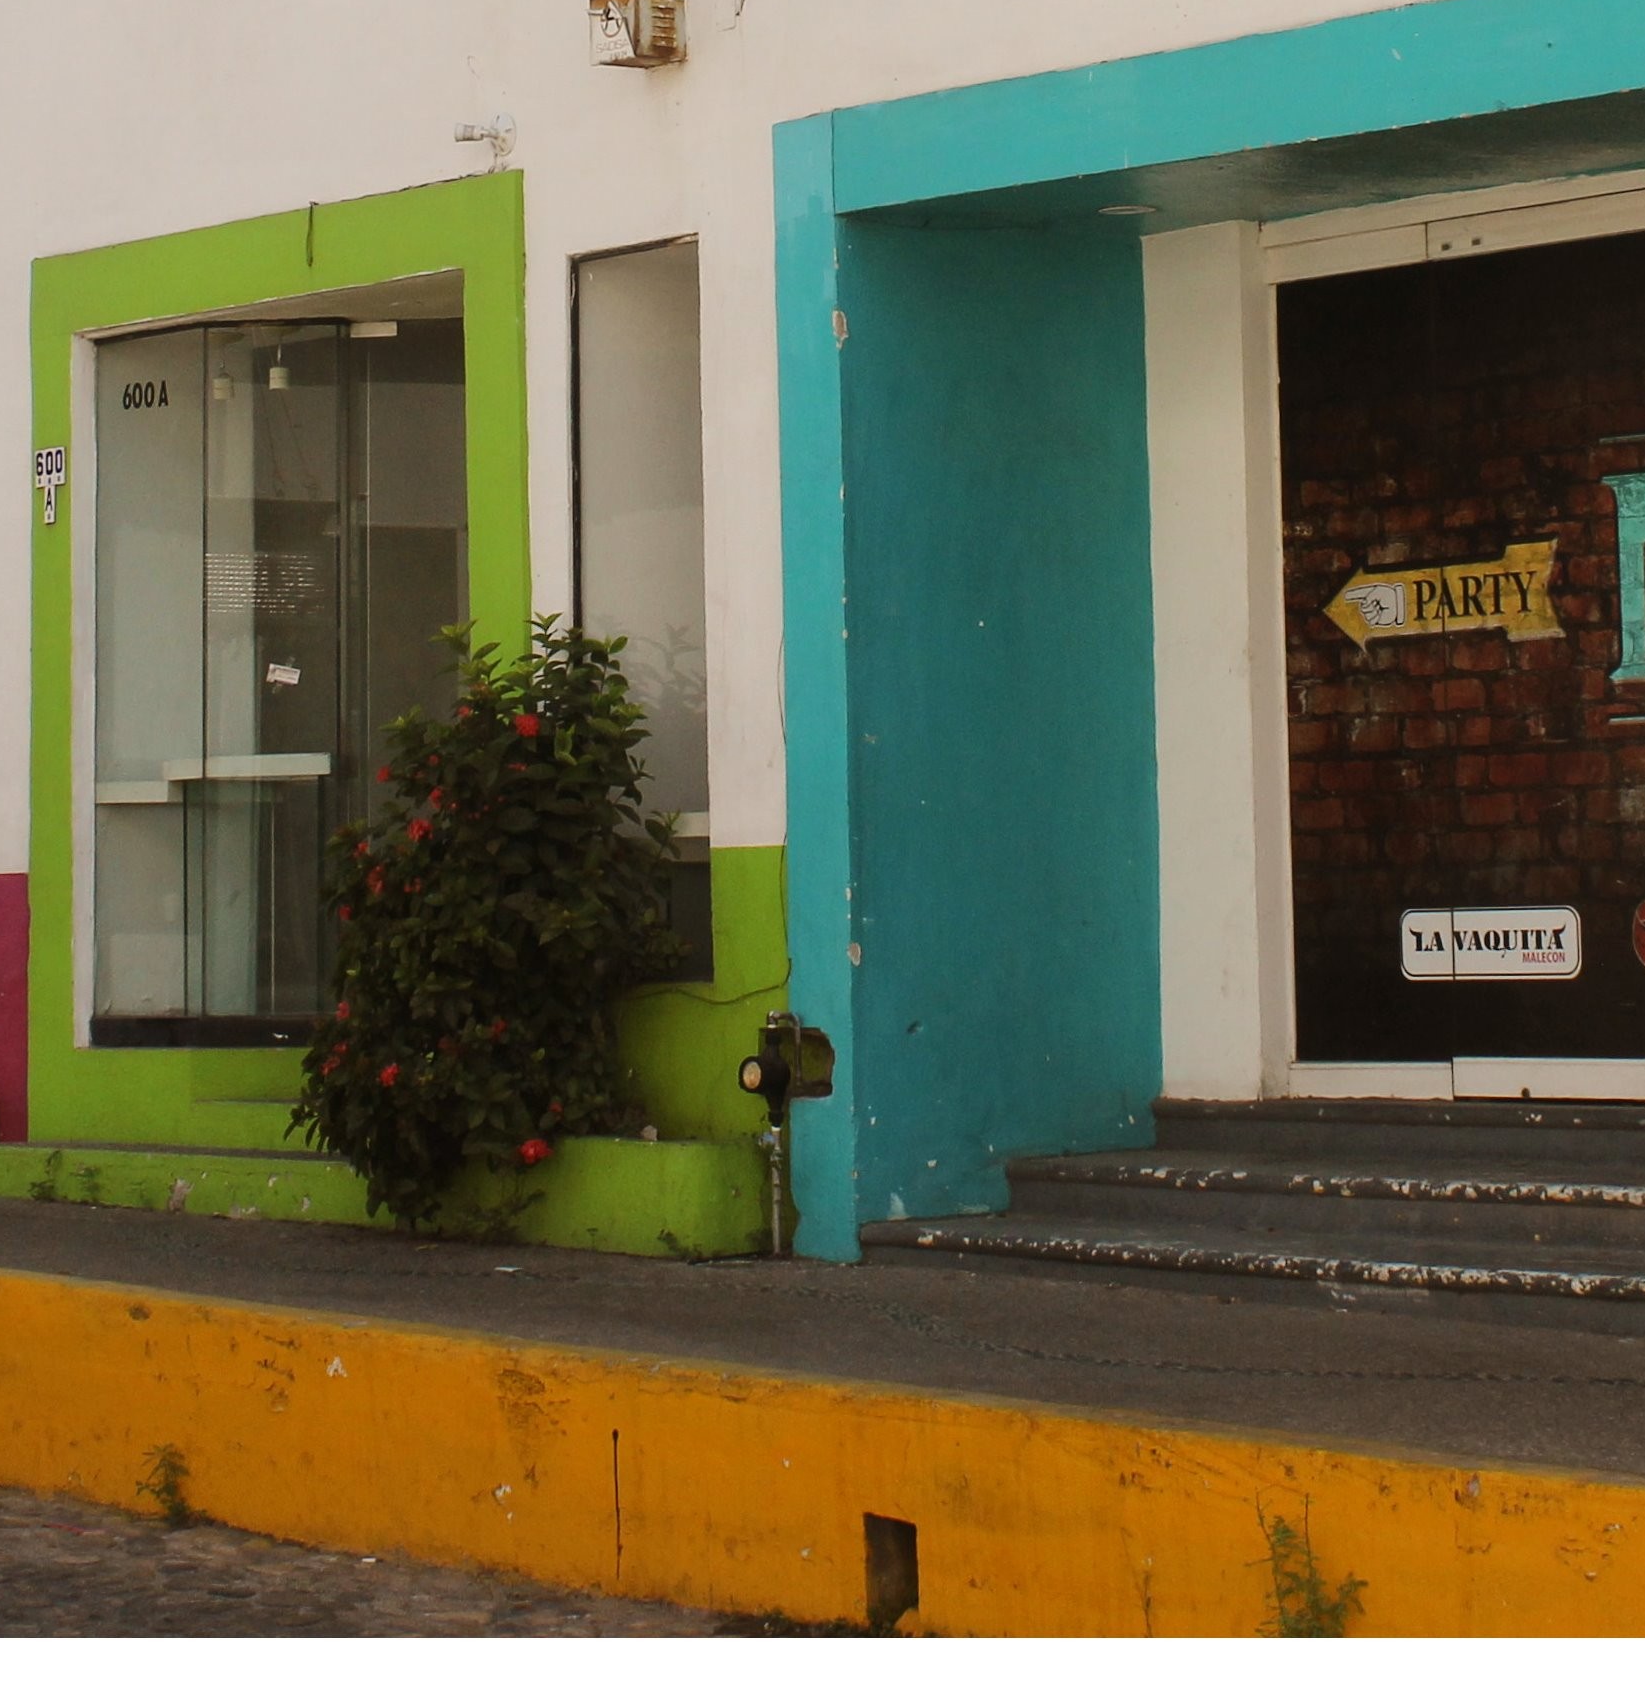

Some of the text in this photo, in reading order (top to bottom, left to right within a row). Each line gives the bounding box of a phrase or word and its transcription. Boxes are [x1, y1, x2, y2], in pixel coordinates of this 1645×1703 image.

[122, 379, 169, 410] 600 A
[36, 449, 63, 477] 600
[44, 487, 53, 512] A
[1412, 570, 1537, 622] PARTY
[1409, 924, 1567, 958] LA VAQUITA
[1522, 952, 1566, 964] MALECON
